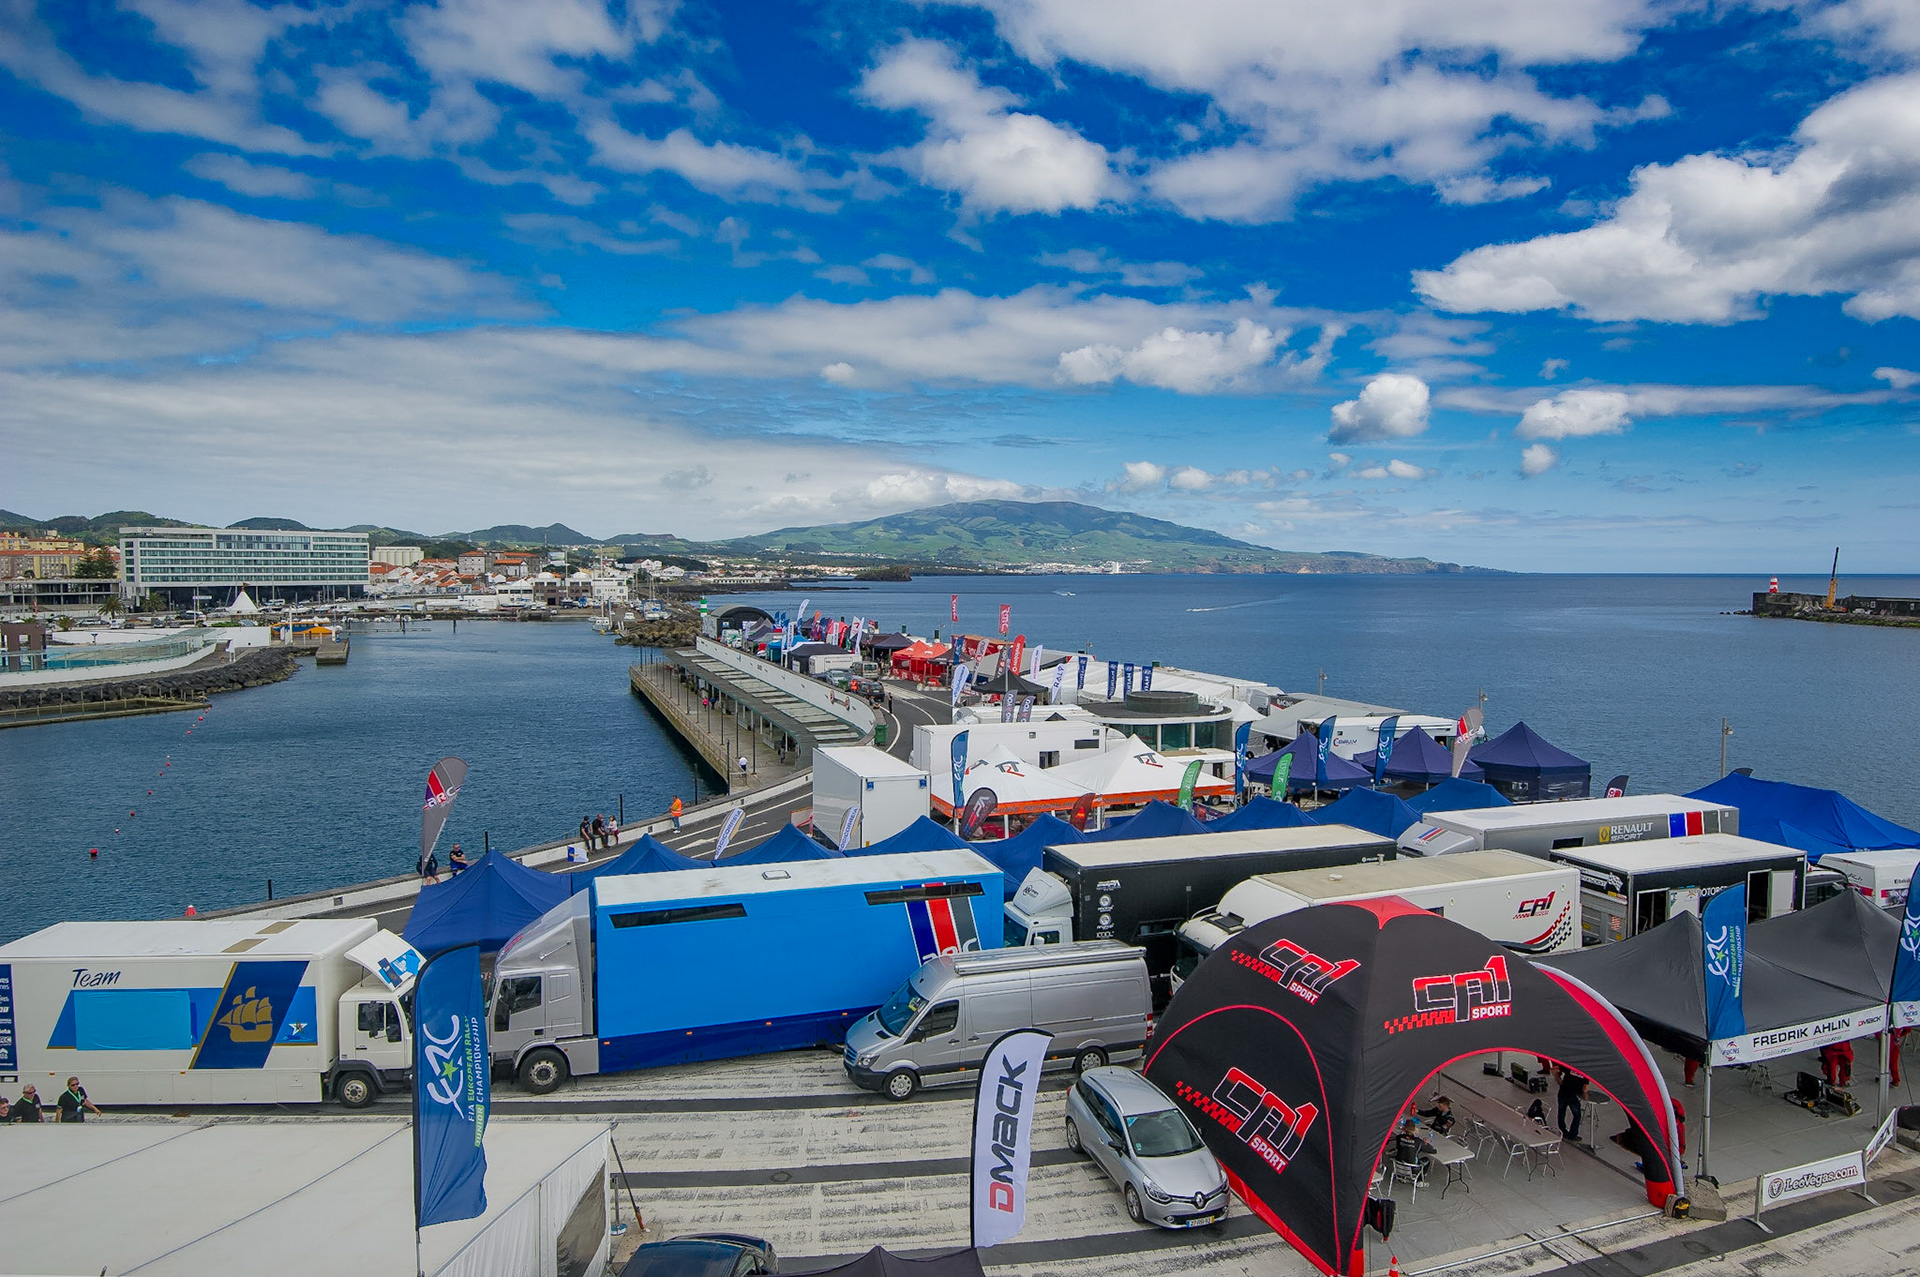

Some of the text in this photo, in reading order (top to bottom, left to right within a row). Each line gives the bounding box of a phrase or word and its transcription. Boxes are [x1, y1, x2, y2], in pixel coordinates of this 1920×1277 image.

[1609, 833, 1643, 842] SPORT
[1610, 822, 1653, 836] RENAULT
[72, 968, 121, 988] Team
[1289, 982, 1318, 1004] SPORT
[1472, 1004, 1510, 1019] SPORT
[1753, 1018, 1850, 1047] FREDRIK AHLIN
[471, 1017, 483, 1102] CHAMPIONSHIP
[466, 1048, 475, 1101] EUROPEAN
[1250, 1137, 1286, 1170] SPORT
[1785, 1165, 1858, 1192] LeoVegas.com
